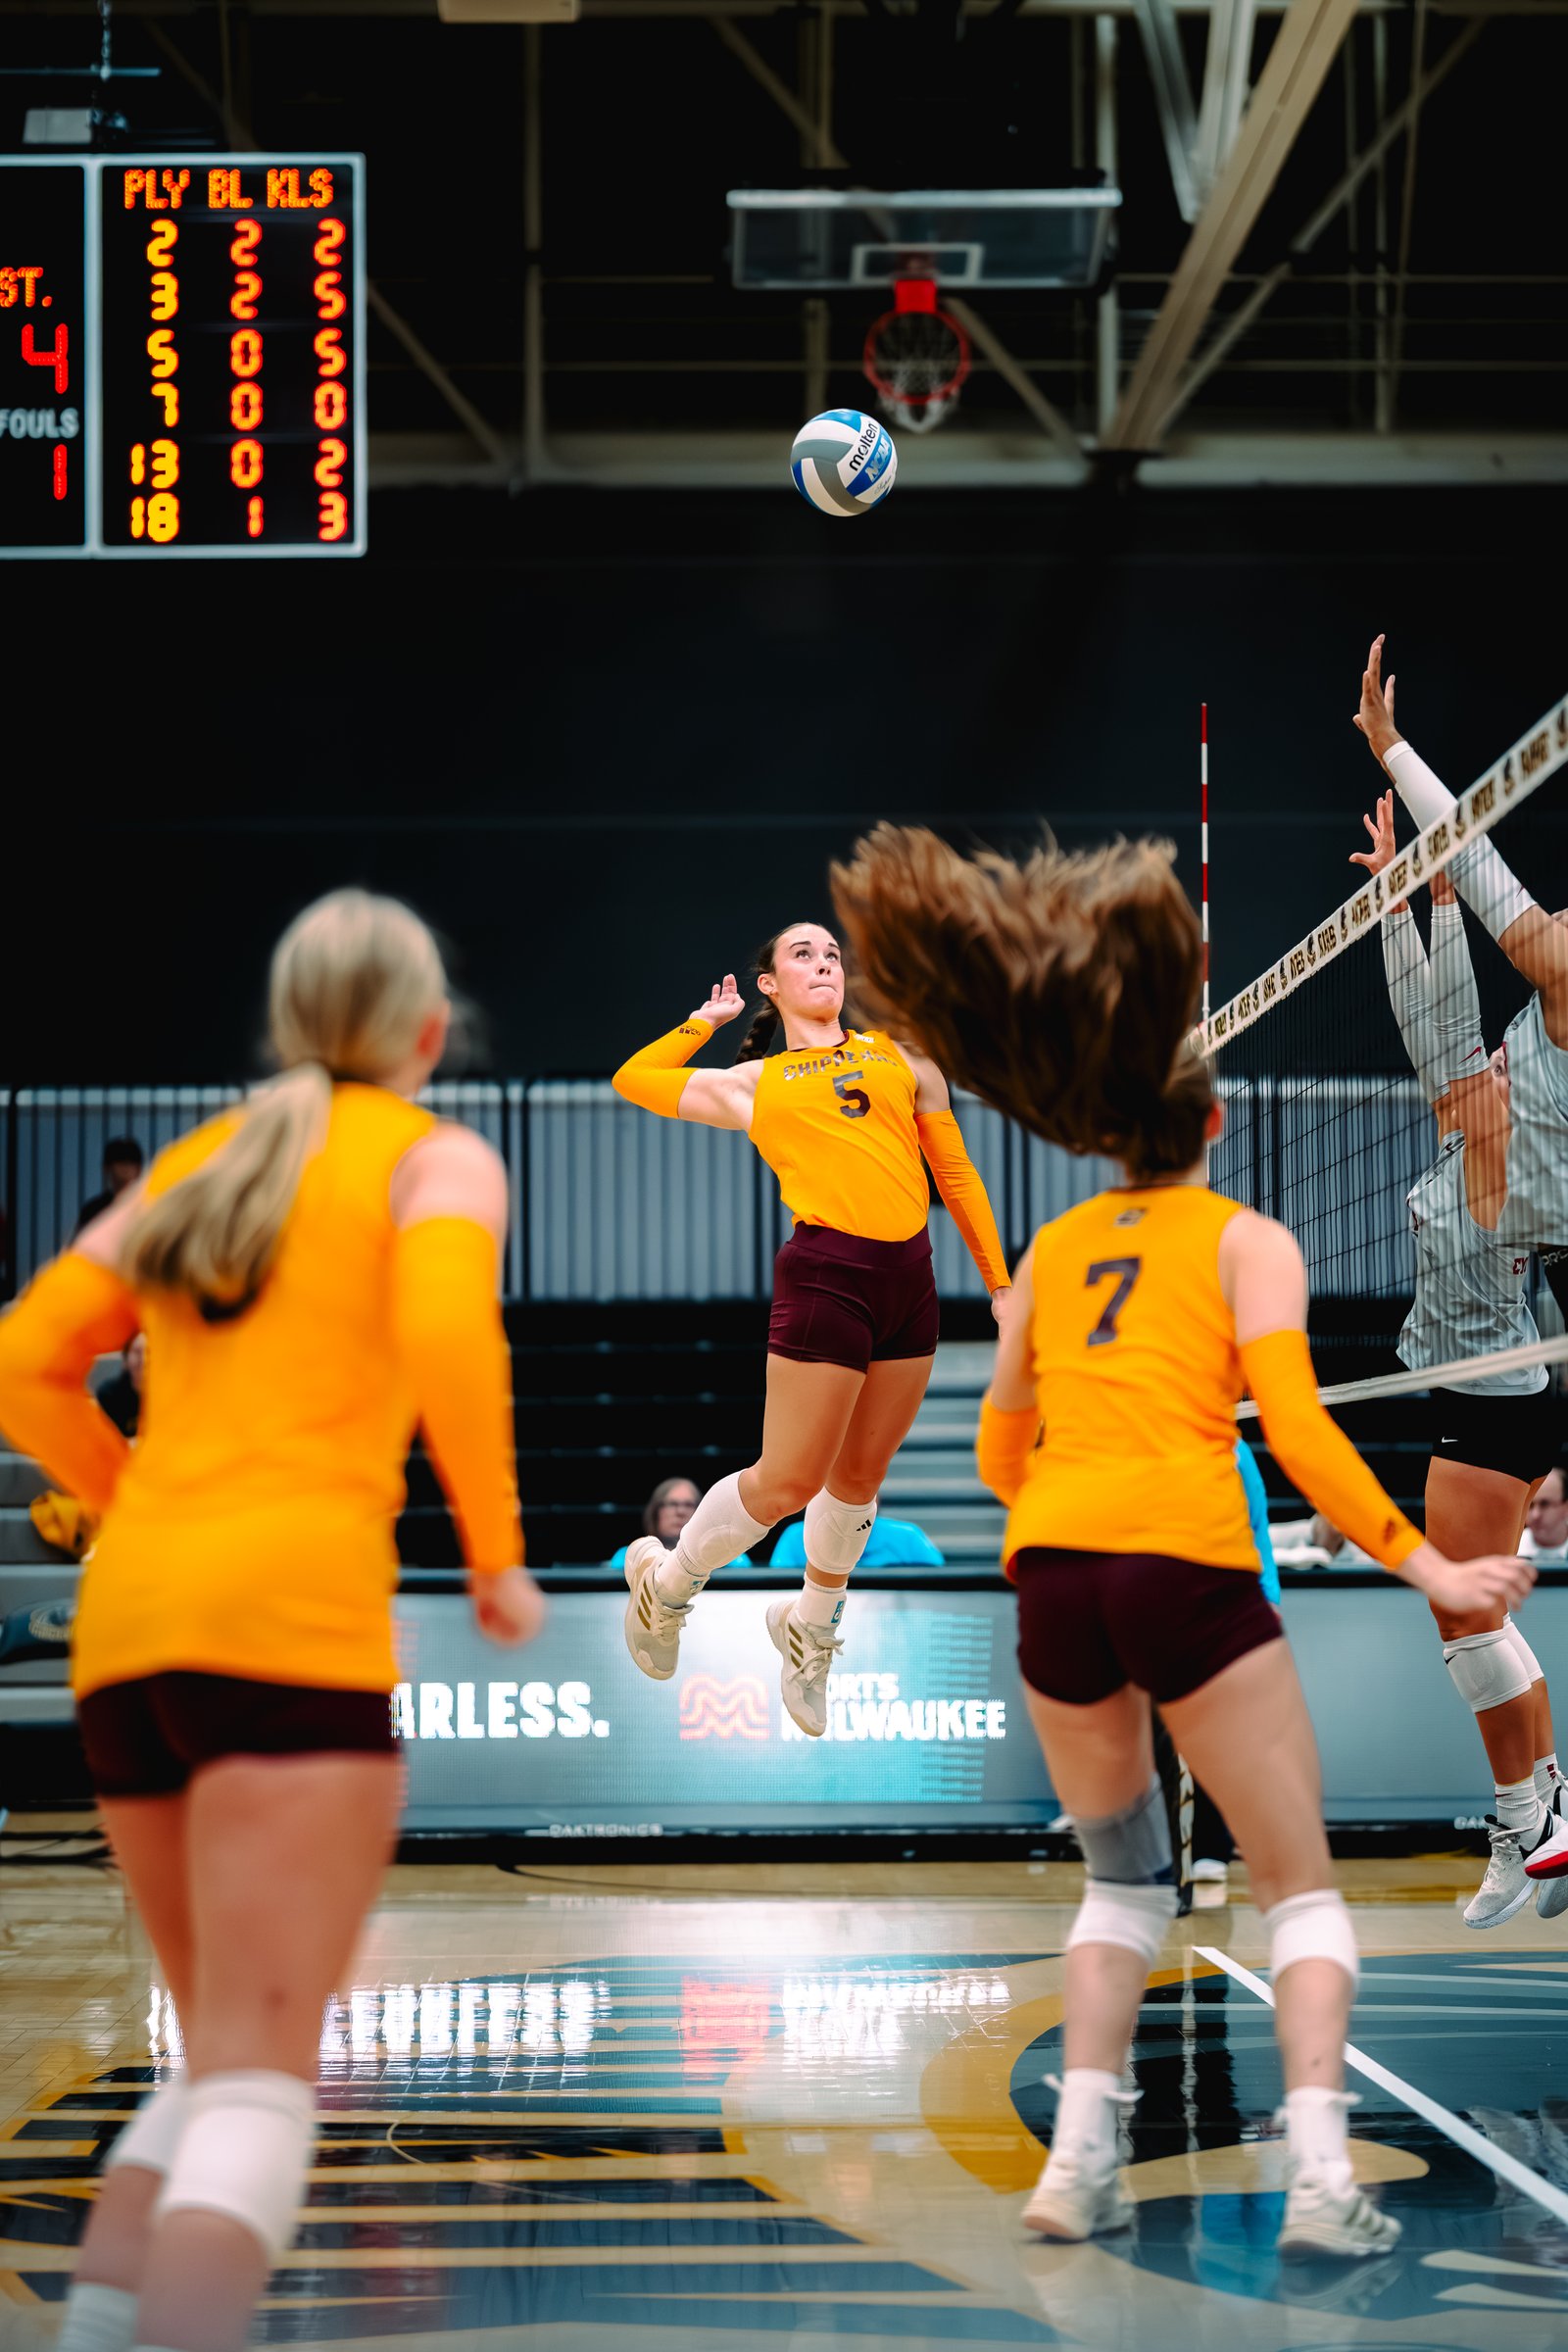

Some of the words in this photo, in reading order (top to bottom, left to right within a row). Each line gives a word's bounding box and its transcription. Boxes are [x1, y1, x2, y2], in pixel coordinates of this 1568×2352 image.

[124, 169, 190, 209] PLY
[208, 169, 254, 209] BL
[267, 169, 334, 209] KLS
[147, 219, 179, 267] 2
[229, 219, 263, 267] 2
[314, 219, 346, 267] 2
[150, 271, 179, 320] 3
[229, 271, 263, 320] 2
[314, 271, 346, 320] 5
[21, 322, 69, 394] 4
[147, 328, 179, 378] 5
[229, 328, 264, 377] 0
[314, 327, 347, 376] 5
[150, 382, 179, 427] 7
[229, 381, 264, 430] 0
[314, 381, 347, 430] 0
[130, 439, 179, 489] 13
[229, 438, 264, 488] 0
[314, 438, 347, 487] 2
[849, 422, 878, 472] molten
[53, 444, 68, 501] 1
[130, 492, 179, 542] 18
[248, 495, 264, 537] 1
[318, 491, 348, 541] 3
[832, 1070, 870, 1119] 5
[1085, 1257, 1141, 1347] 7
[389, 1682, 610, 1740] ARLESS.
[825, 1673, 900, 1700] ORTS
